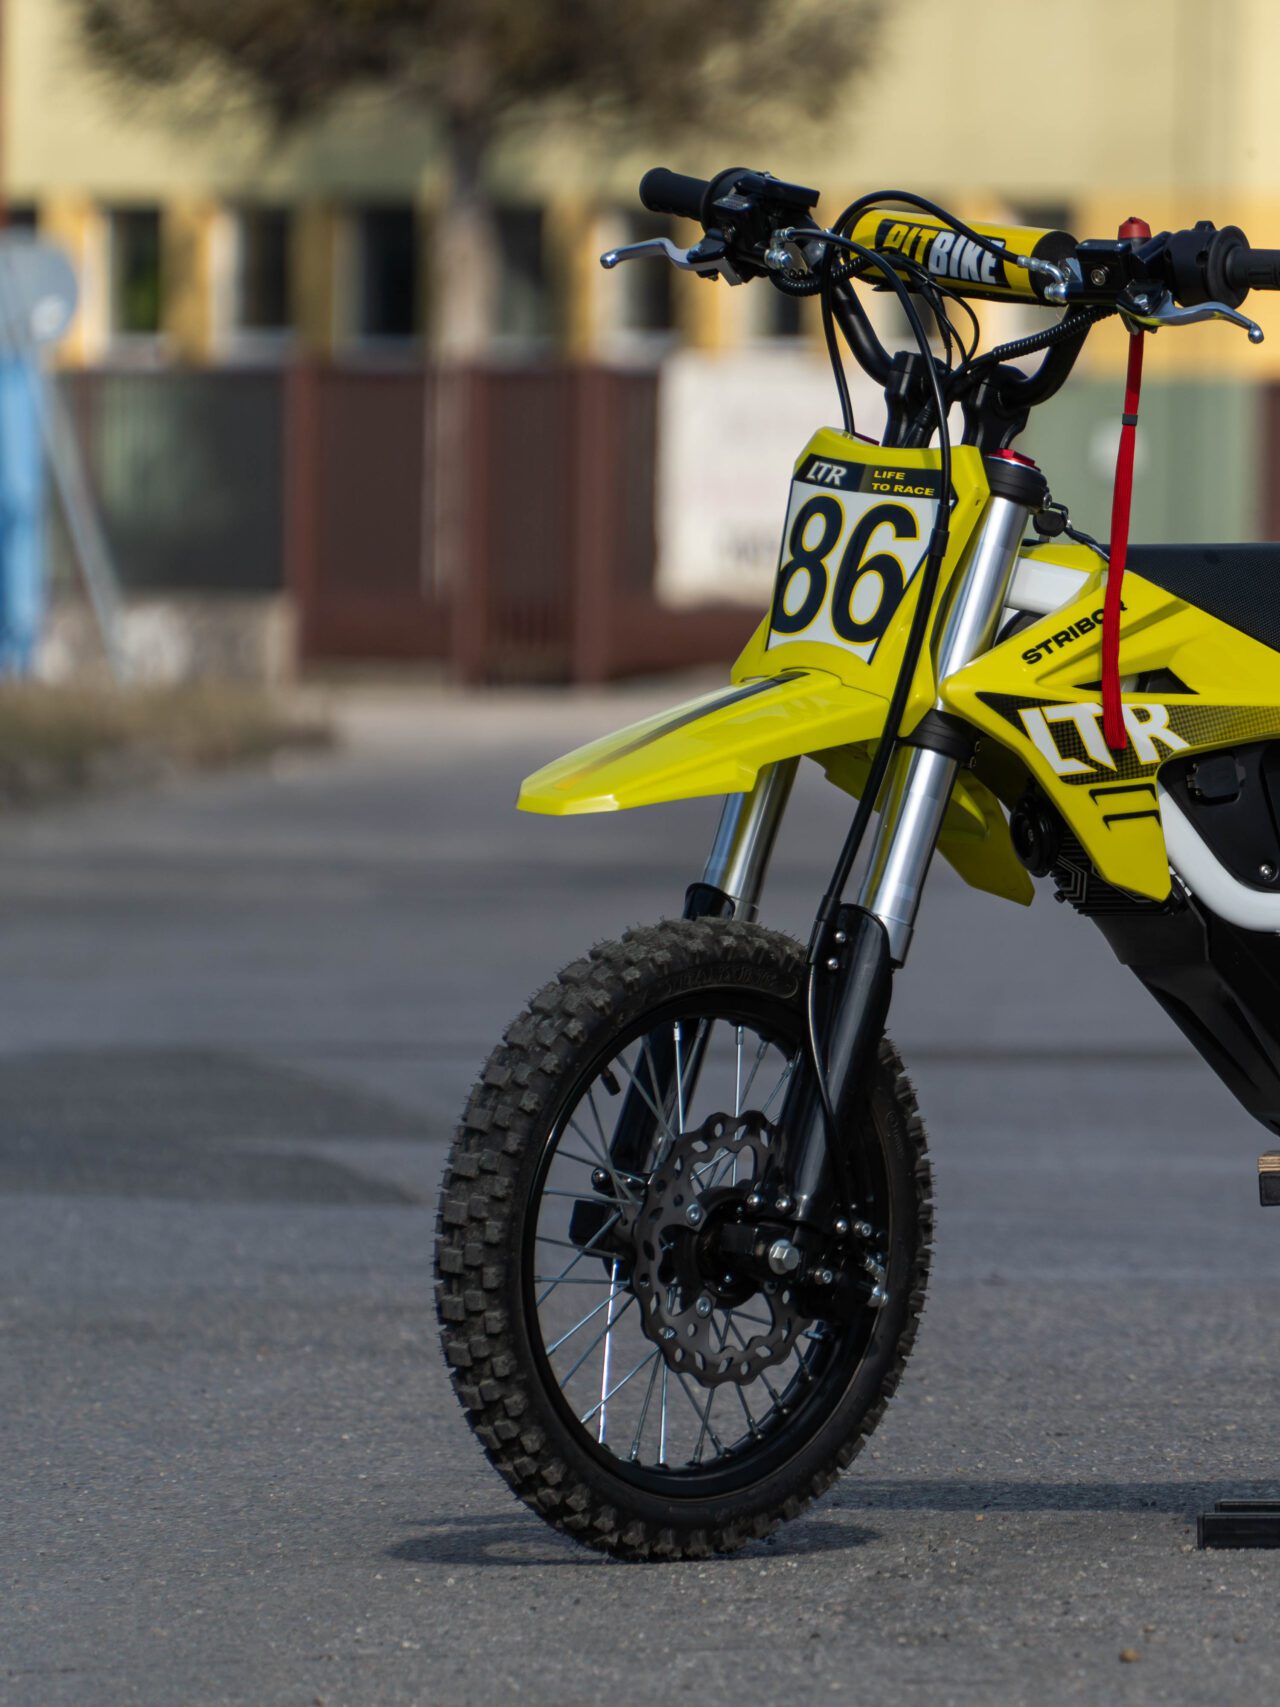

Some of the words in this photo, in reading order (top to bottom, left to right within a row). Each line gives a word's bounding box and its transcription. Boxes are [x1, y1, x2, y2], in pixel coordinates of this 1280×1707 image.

[806, 460, 848, 486] LTR
[873, 470, 906, 480] LIFE
[871, 482, 890, 491] TO
[893, 484, 935, 496] RACE
[770, 492, 920, 646] 86
[1016, 701, 1192, 776] LTR
